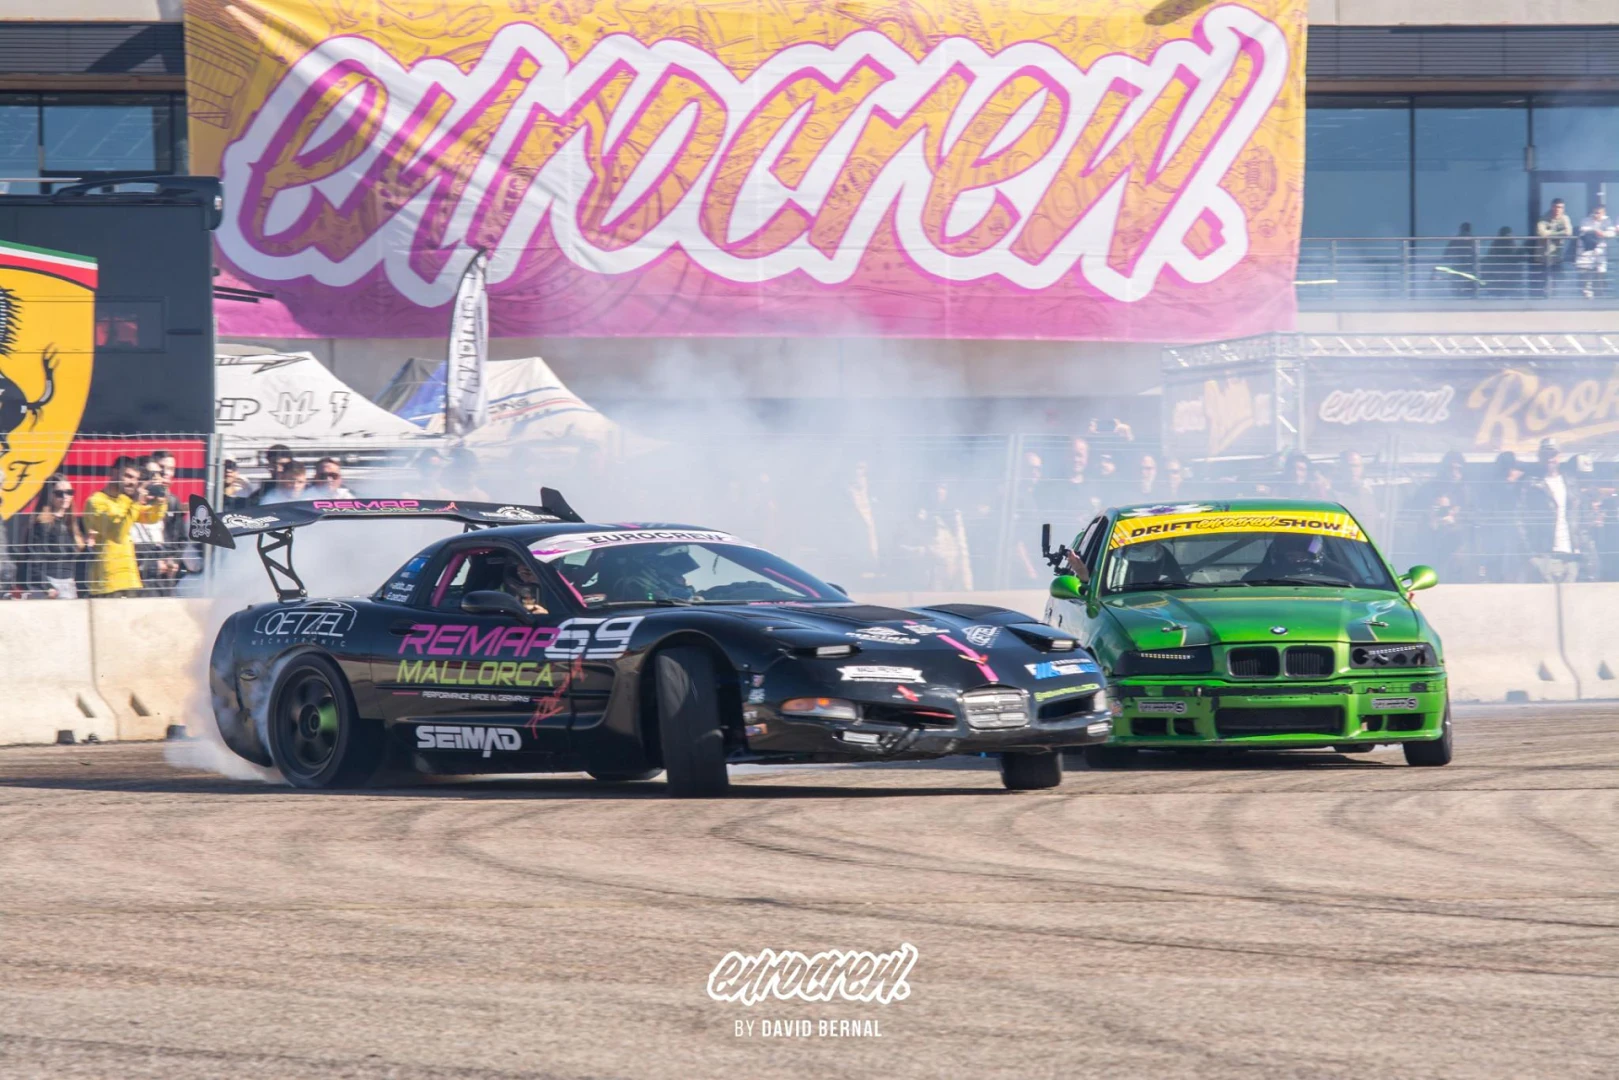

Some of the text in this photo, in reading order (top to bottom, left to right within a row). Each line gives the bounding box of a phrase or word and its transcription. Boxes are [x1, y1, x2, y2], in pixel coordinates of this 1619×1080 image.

[313, 500, 419, 510] REMAP
[588, 532, 723, 544] EUROCREW
[1130, 520, 1200, 538] DRIFT
[1276, 518, 1342, 531] SHOW
[264, 612, 344, 637] OETZEL
[398, 624, 562, 657] REMAP
[544, 616, 645, 660] 69
[396, 659, 554, 688] MALLORCA
[422, 690, 469, 700] PERFORMANCE
[470, 693, 489, 701] MADE
